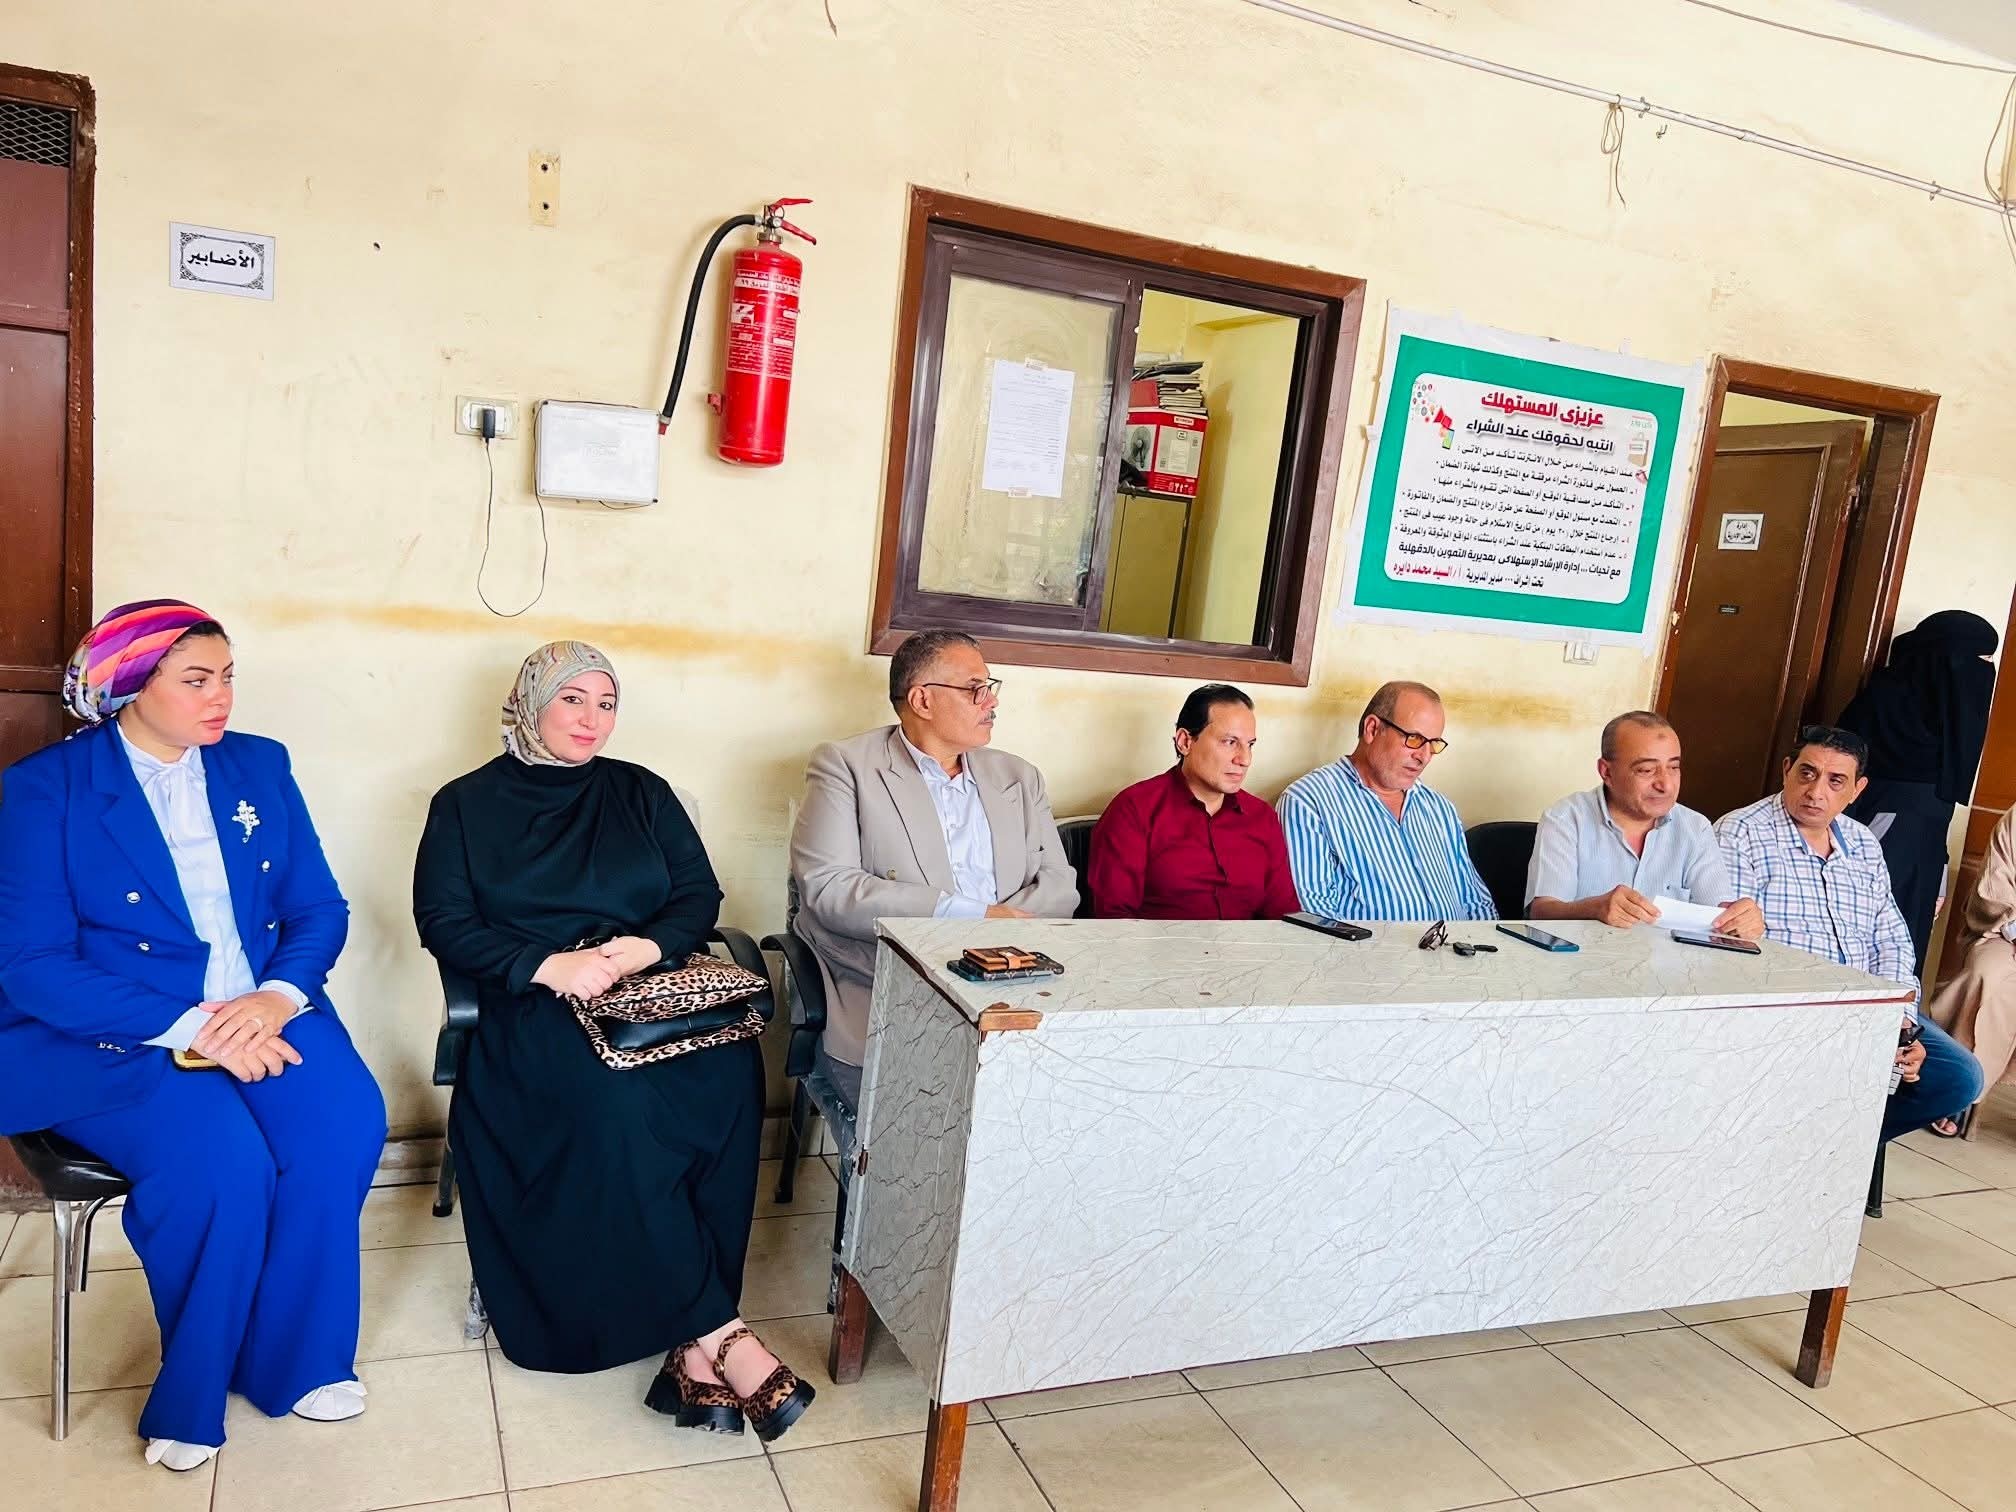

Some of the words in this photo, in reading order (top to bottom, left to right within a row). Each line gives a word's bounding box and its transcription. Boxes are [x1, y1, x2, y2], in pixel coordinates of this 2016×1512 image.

[187, 249, 254, 268] الأضابير
[1481, 392, 1557, 417] المستهلك
[1559, 405, 1603, 427] عزيزى
[1465, 417, 1504, 435] الشراء
[1505, 424, 1528, 440] عند
[1531, 429, 1584, 447] لحقوقك
[1585, 438, 1613, 452] انتبه
[1482, 447, 1494, 457] من
[1439, 459, 1462, 469] الضمان
[1462, 461, 1480, 473] شهادة
[1543, 456, 1562, 466] خلال
[1562, 459, 1573, 469] من
[1574, 461, 1599, 472] بالشراء
[1480, 465, 1503, 477] وكذلك
[1503, 467, 1520, 479] المنتج
[1599, 465, 1618, 475] القيام
[1618, 468, 1633, 477] عند
[1437, 476, 1453, 486] منها
[1520, 472, 1529, 481] مع
[1552, 474, 1572, 486] الشراء
[1572, 477, 1593, 488] فاتورة
[1453, 477, 1478, 491] بالشراء
[1479, 482, 1497, 492] تقوم
[1605, 483, 1628, 493] الحصول
[1406, 488, 1435, 503] والفاتورة
[1512, 485, 1534, 496] الصفحة
[1540, 490, 1561, 502] الموقع
[1435, 493, 1461, 506] والضمان
[1461, 496, 1480, 508] المنتج
[1562, 492, 1590, 504] مصداقية
[1590, 498, 1602, 507] من
[1402, 506, 1421, 518] المنتج
[1497, 501, 1512, 512] طرق
[1512, 504, 1523, 514] عن
[1524, 504, 1547, 515] الصفحة
[1431, 513, 1445, 522] عيب
[1447, 513, 1463, 524] وجود
[1464, 513, 1478, 524] حالة
[1554, 508, 1572, 520] الموقع
[1599, 513, 1621, 525] التحدث
[1489, 518, 1513, 528] الاستلام
[1513, 520, 1531, 532] تاريخ
[1590, 516, 1598, 525] مع
[1399, 523, 1426, 537] والمعروفة
[1427, 526, 1452, 539] الموثوقة
[1531, 524, 1540, 533] من
[1569, 528, 1583, 539] خلال
[1451, 530, 1472, 542] المواقع
[1473, 533, 1497, 546] باستثناء
[1583, 529, 1600, 541] المنتج
[1498, 536, 1518, 547] الشراء
[1519, 539, 1531, 548] عند
[1532, 539, 1554, 552] البنكية
[1398, 541, 1436, 557] بالدقهلية
[1436, 547, 1467, 559] التموين
[1553, 543, 1580, 555] البطاقات
[1467, 549, 1496, 564] بمديرية
[1411, 563, 1431, 575] محمد
[1538, 558, 1563, 572] الإرشاد
[1563, 560, 1580, 574] إدارة
[1588, 563, 1610, 576] تحيات
[1432, 565, 1452, 579] السيد
[1465, 567, 1488, 583] المديرية
[1608, 568, 1620, 579] مع
[1487, 574, 1503, 585] مدير
[1530, 575, 1544, 587] تحت
